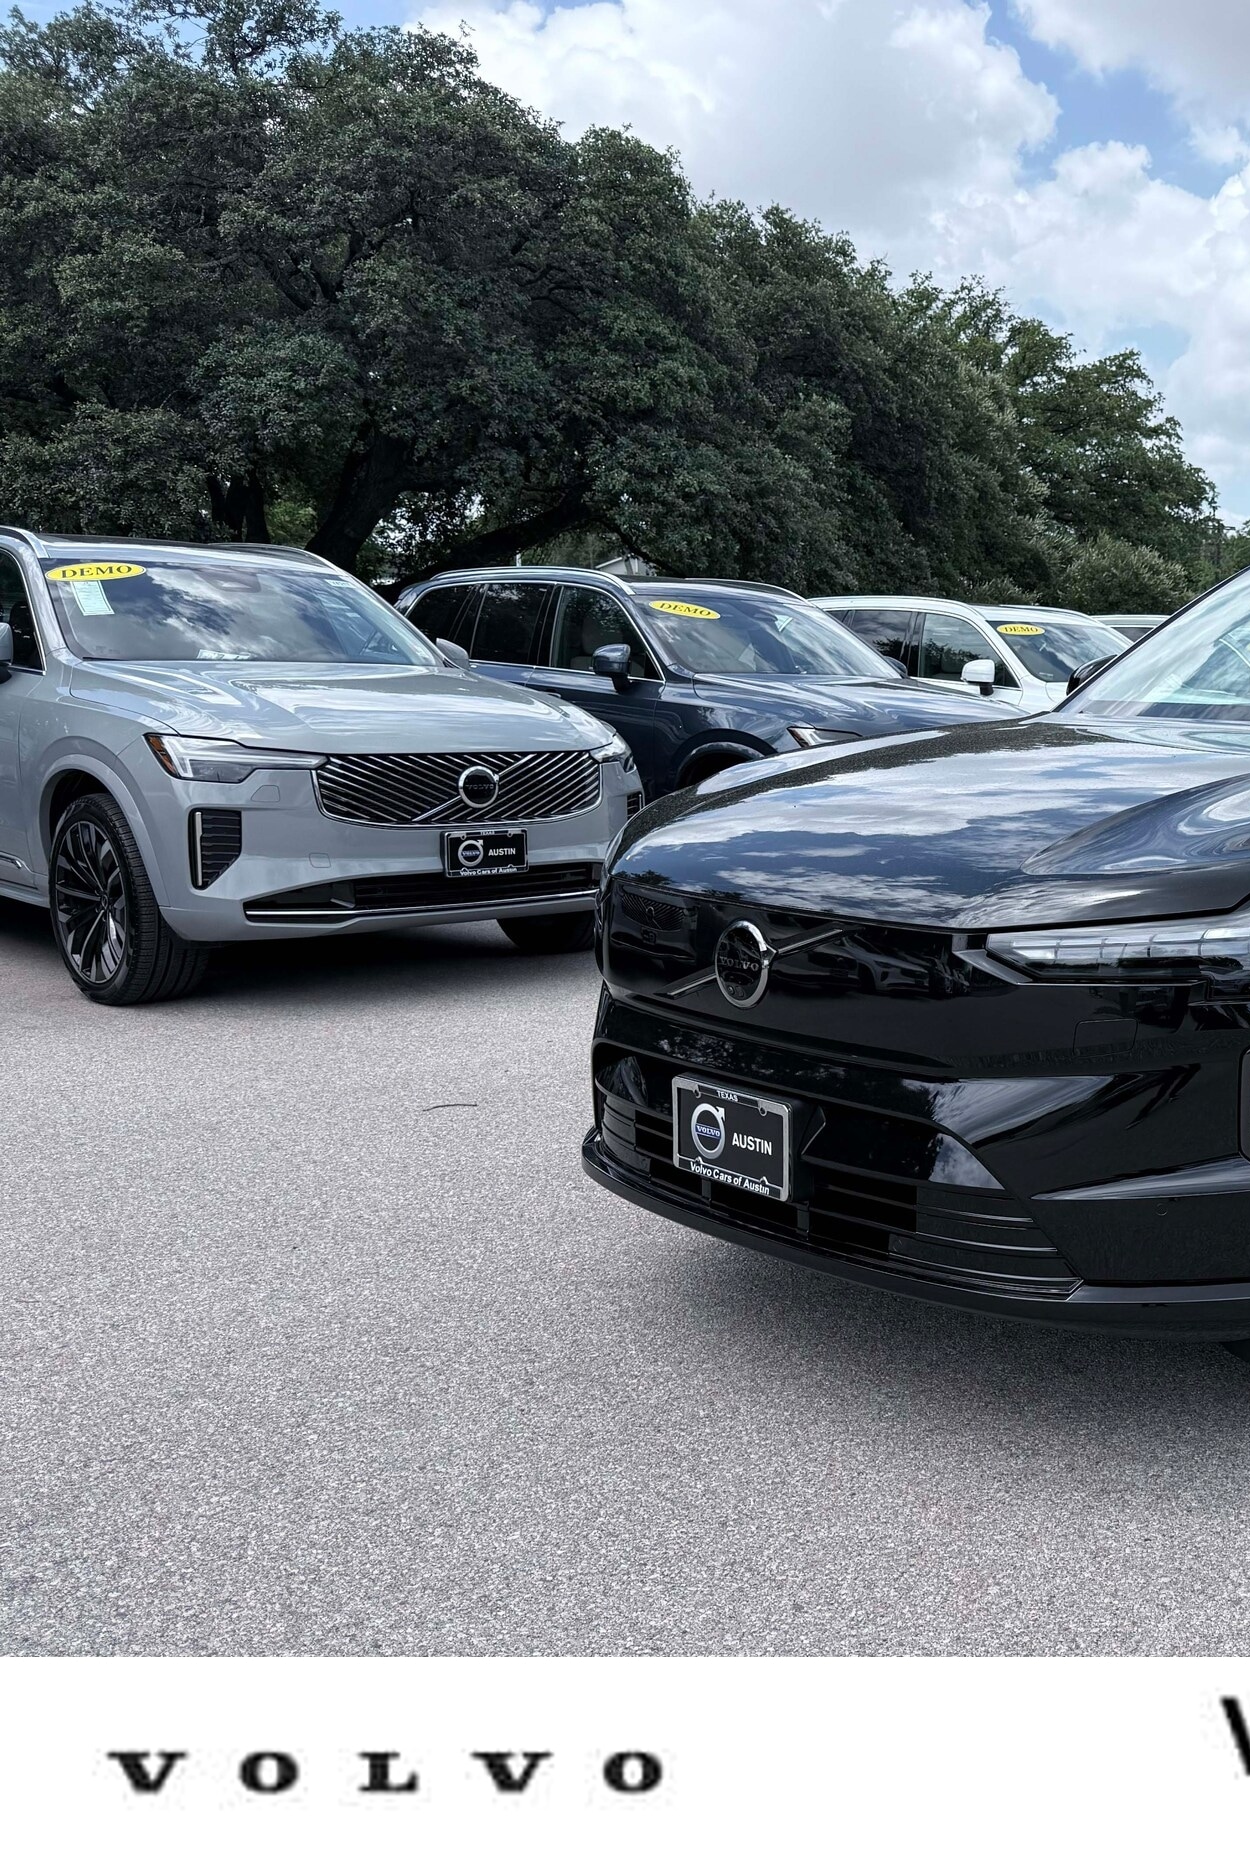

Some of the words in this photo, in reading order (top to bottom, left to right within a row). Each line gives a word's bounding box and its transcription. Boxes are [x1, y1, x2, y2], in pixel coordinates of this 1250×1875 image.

[61, 565, 132, 578] DEMO
[659, 602, 711, 616] DEMO
[488, 847, 516, 857] AUSTIN
[720, 956, 759, 972] VOLVO
[716, 1090, 739, 1102] TEXAS
[697, 1126, 720, 1137] VOLVO
[732, 1132, 772, 1156] AUSTIN
[690, 1161, 712, 1177] Volvo
[713, 1168, 732, 1184] Cars
[733, 1175, 742, 1186] of
[743, 1178, 770, 1196] Austin
